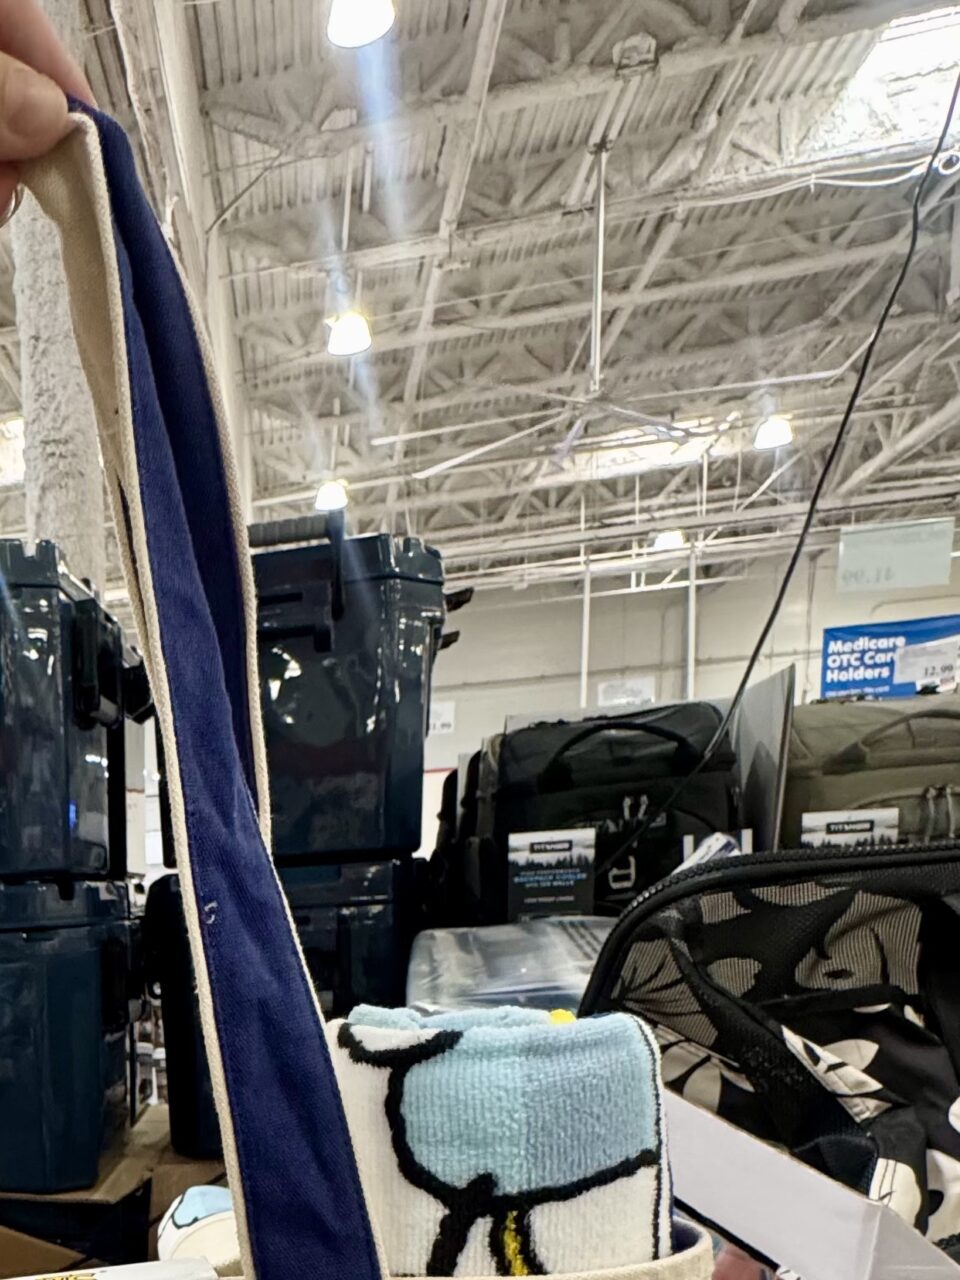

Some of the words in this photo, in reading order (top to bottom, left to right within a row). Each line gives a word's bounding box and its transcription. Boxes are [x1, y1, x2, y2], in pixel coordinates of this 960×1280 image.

[827, 635, 905, 654] Medicare
[827, 652, 861, 668] OTC
[826, 665, 890, 683] Holders
[924, 663, 954, 678] 12.99
